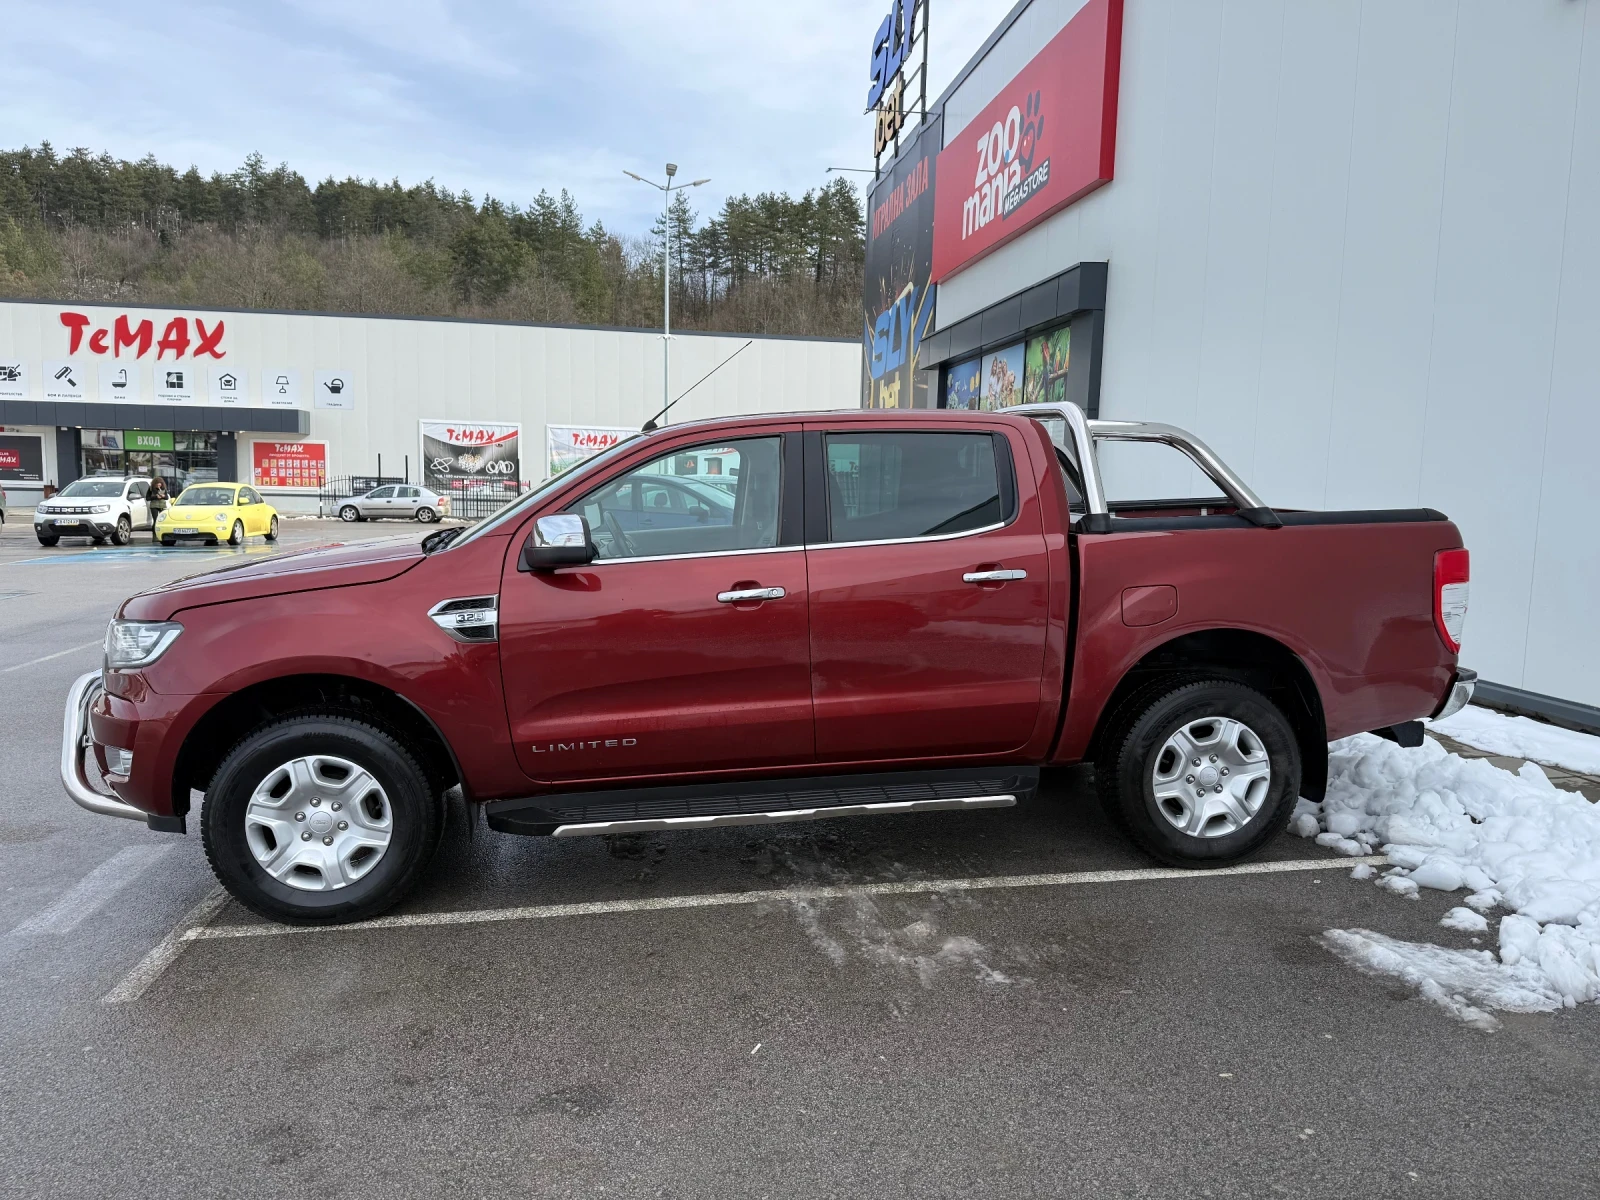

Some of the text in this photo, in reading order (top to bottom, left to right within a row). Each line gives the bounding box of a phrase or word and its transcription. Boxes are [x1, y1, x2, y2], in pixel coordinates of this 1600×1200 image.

[867, 0, 918, 110] SLY
[874, 72, 904, 158] bet
[872, 155, 929, 241] ИГРАЛНА ЗАЛА
[1003, 160, 1050, 216] MEGASTORE
[60, 311, 227, 361] TeMAX
[871, 285, 919, 380] SLY
[0, 456, 17, 464] MAX
[137, 435, 161, 447] ВХОД
[446, 428, 495, 442] TeMAX
[532, 738, 637, 753] LIMITED
